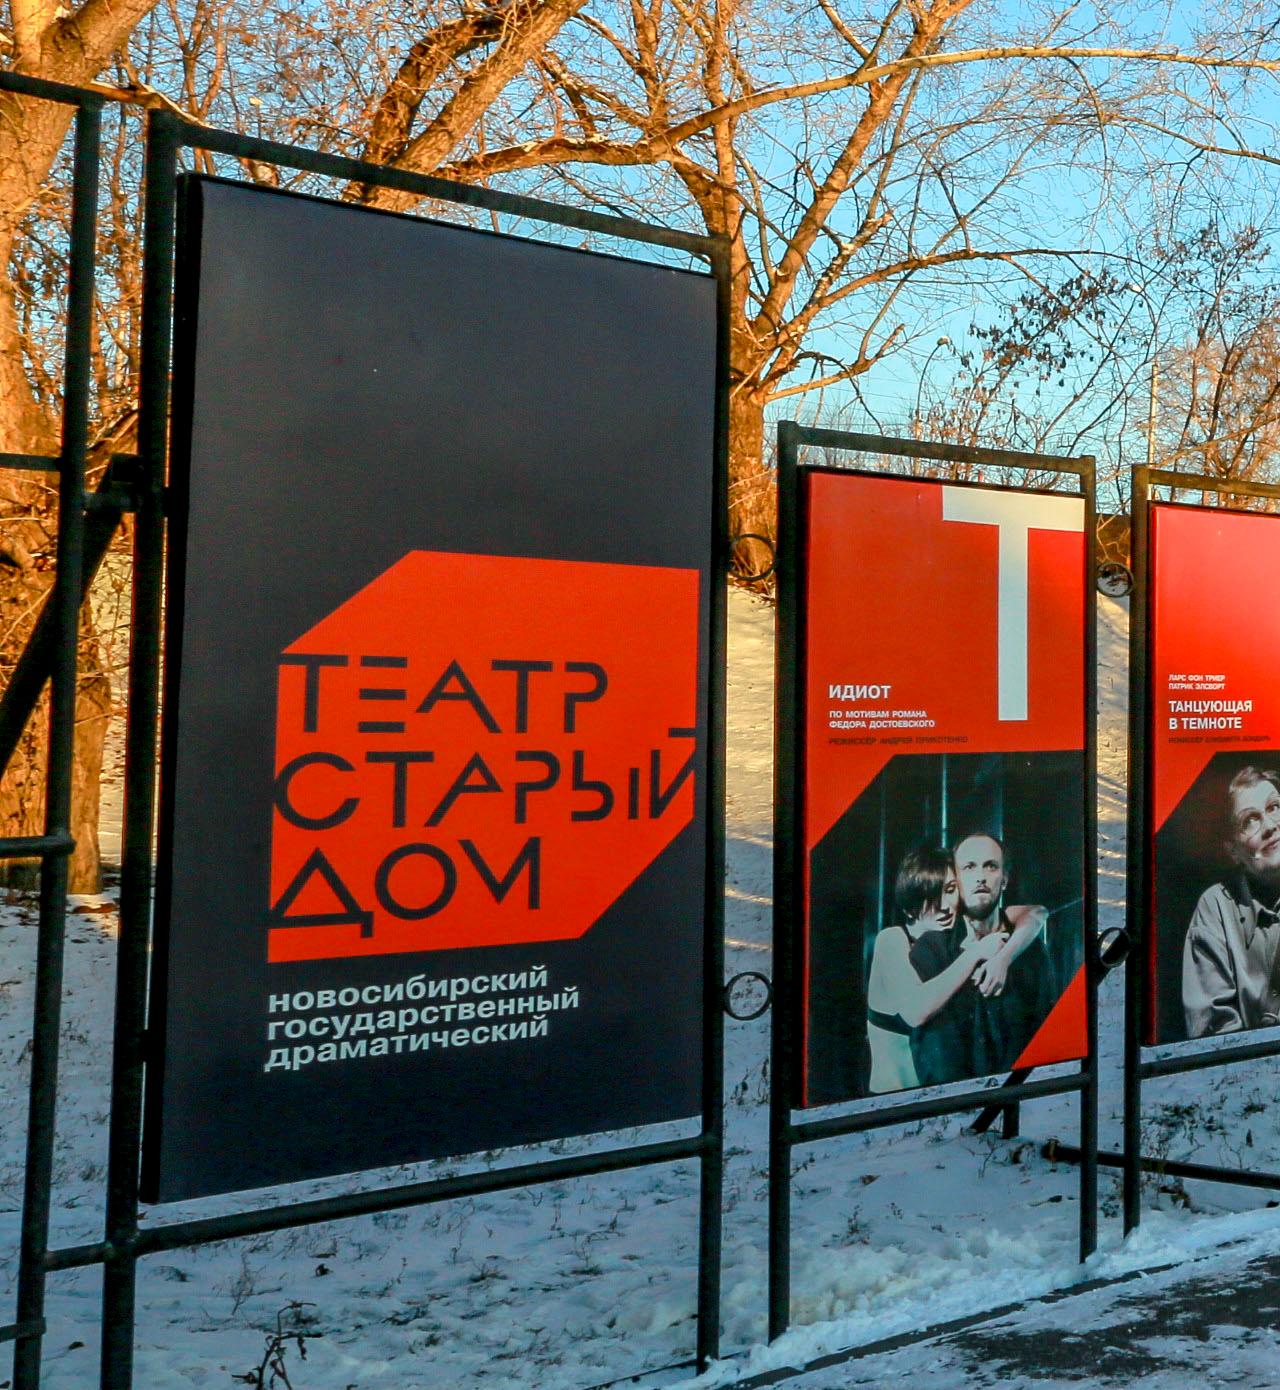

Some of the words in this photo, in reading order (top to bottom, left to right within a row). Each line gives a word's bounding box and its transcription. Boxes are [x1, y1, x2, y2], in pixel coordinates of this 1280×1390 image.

[279, 653, 609, 734] ТЕАТР
[828, 684, 891, 701] ИДИОТ
[1168, 674, 1186, 682] ЛАРС
[1188, 674, 1203, 682] ФОН
[1205, 674, 1226, 682] ТРИЕР
[846, 710, 889, 718] МОТИВАМ
[892, 710, 927, 718] РОМАНА
[1168, 700, 1253, 714] ТАНЦУЮЩАЯ
[1169, 718, 1178, 729] В
[1181, 717, 1242, 729] ТЕМНОТЕ
[869, 719, 935, 729] ДОСТОЕВСКОГО
[272, 727, 697, 832] СТАРЫЙ
[267, 836, 542, 938] ДОМ
[268, 965, 549, 1014] новосибирский
[267, 985, 580, 1041] государственный
[263, 1013, 549, 1073] драматический
